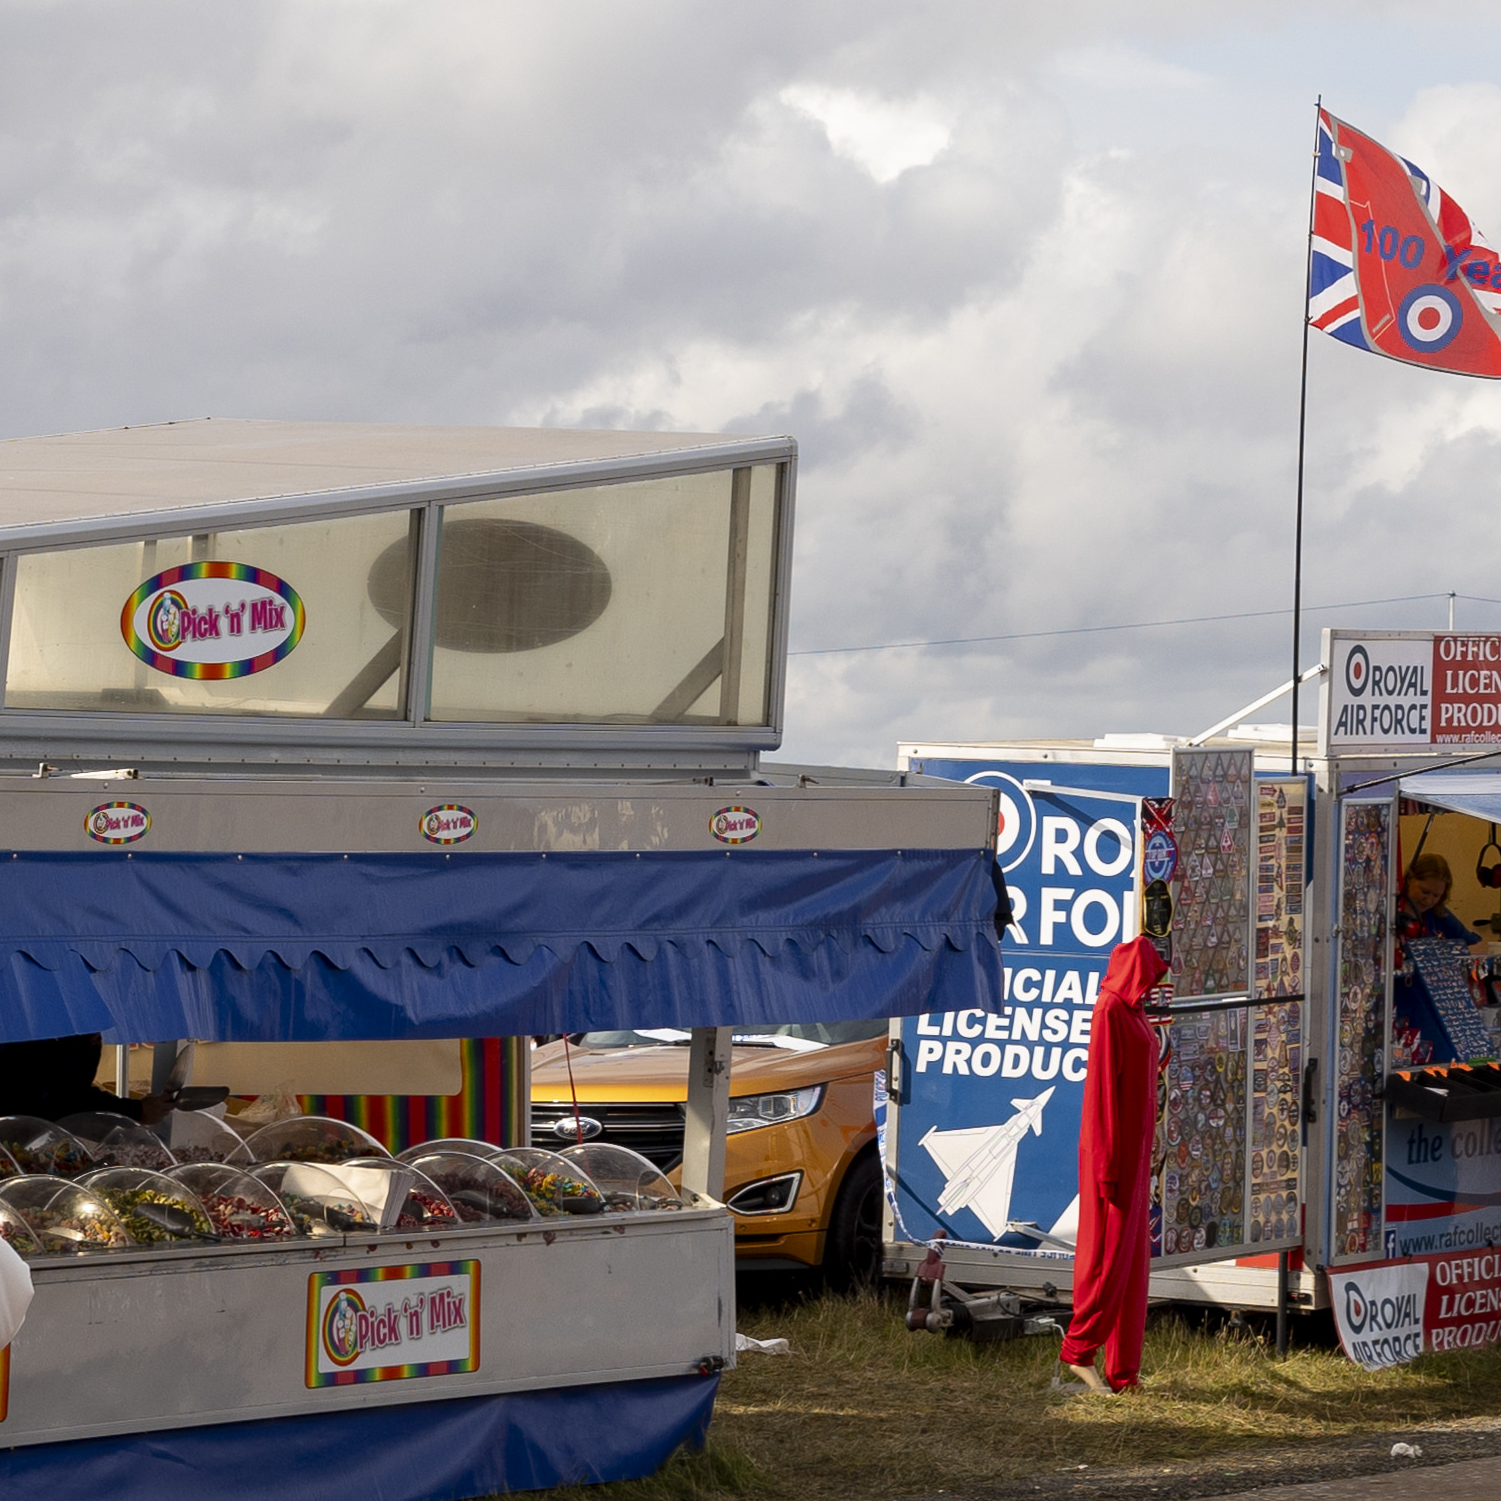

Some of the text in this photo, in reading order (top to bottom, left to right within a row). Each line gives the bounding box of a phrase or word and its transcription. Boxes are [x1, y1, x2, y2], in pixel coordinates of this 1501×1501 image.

[1361, 218, 1425, 269] 100
[180, 607, 220, 641] Pick
[251, 598, 285, 631] Mix
[1371, 665, 1429, 697] ROYAL
[1333, 703, 1428, 736] AIR FORCE
[106, 817, 121, 830] Pick
[131, 814, 145, 827] Mix
[916, 1006, 1092, 1042] LICENSE
[916, 1040, 1088, 1082] PRODUC
[1407, 1124, 1443, 1165] the
[358, 1307, 399, 1349] Pick
[429, 1290, 464, 1330] Mix
[1369, 1293, 1420, 1332] ROYAL
[1370, 1332, 1421, 1364] FORCE
